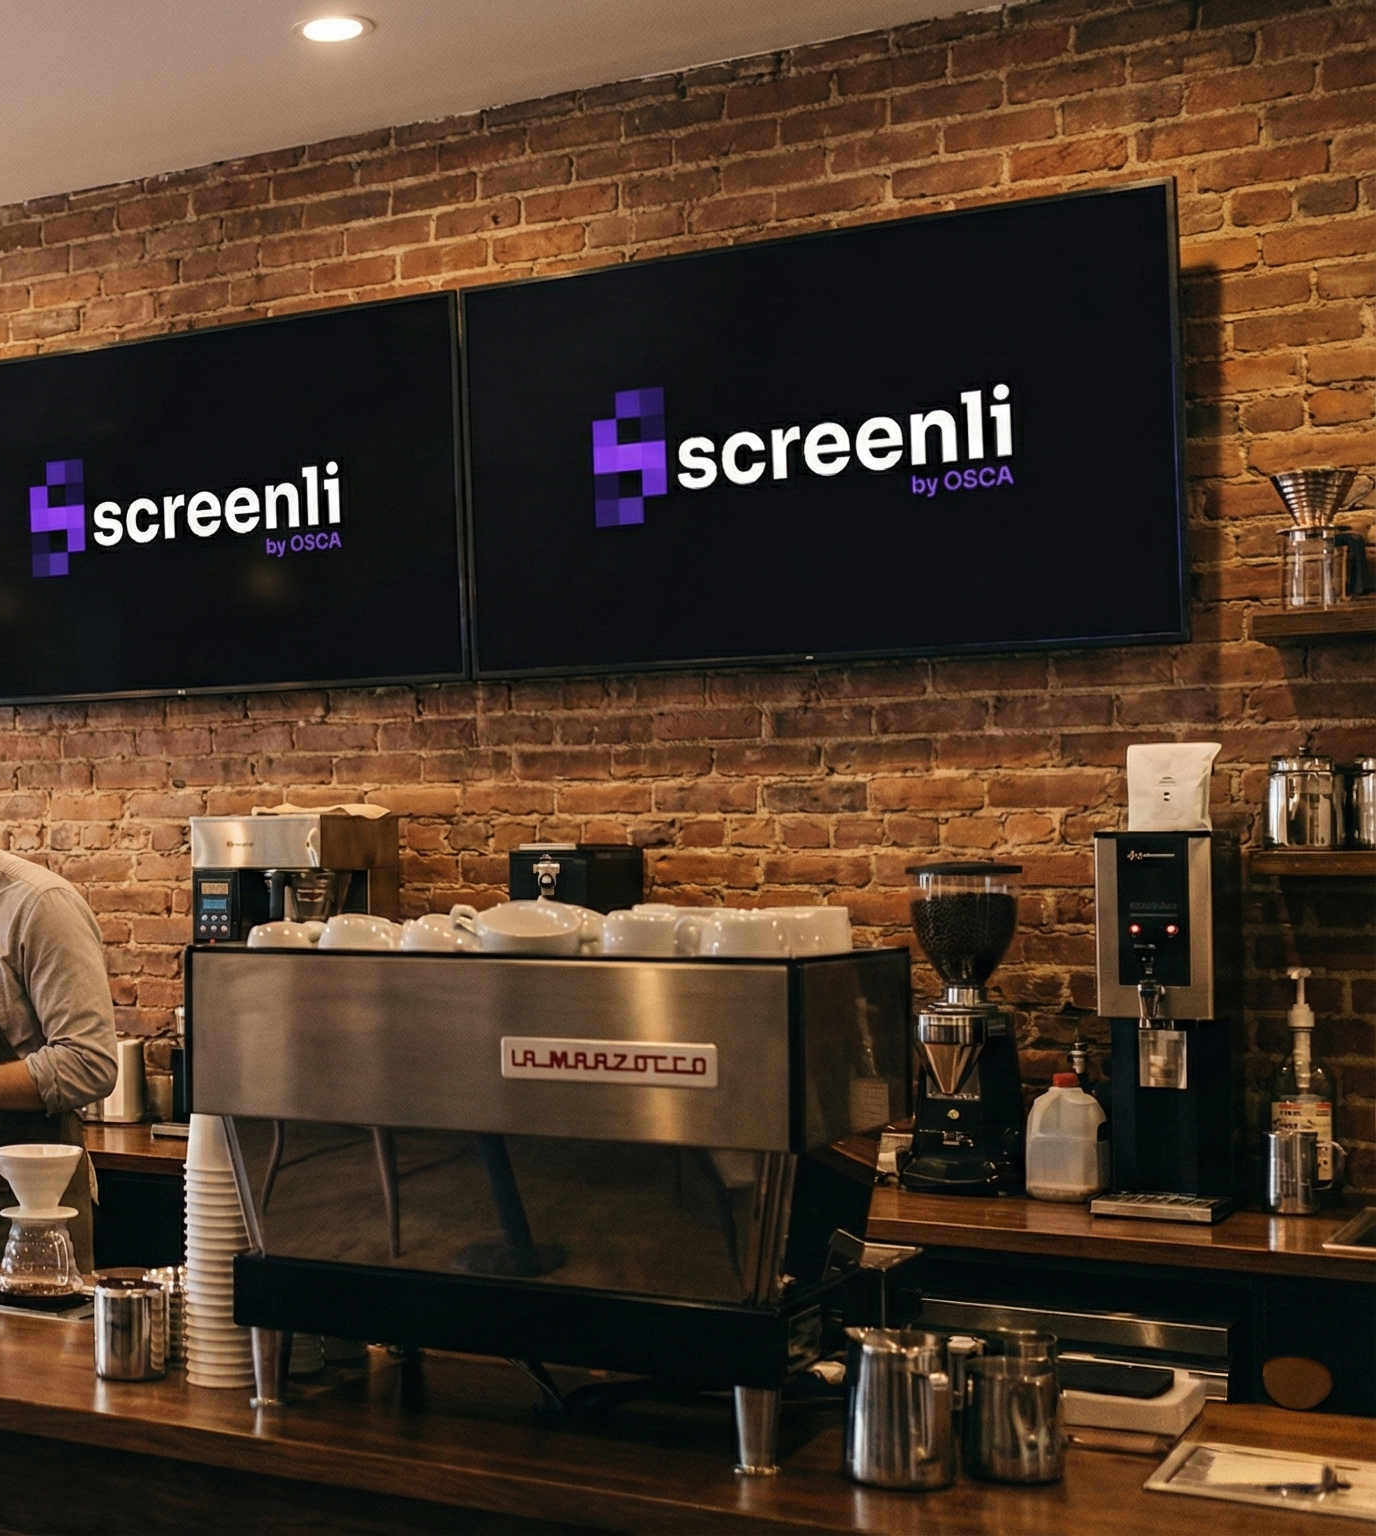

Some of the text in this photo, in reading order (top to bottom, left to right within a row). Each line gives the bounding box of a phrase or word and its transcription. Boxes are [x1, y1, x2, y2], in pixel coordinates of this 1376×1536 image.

[677, 384, 1013, 491] screenli
[93, 461, 341, 547] screenli
[911, 465, 1014, 498] by OSCA
[265, 532, 342, 557] by OSCA
